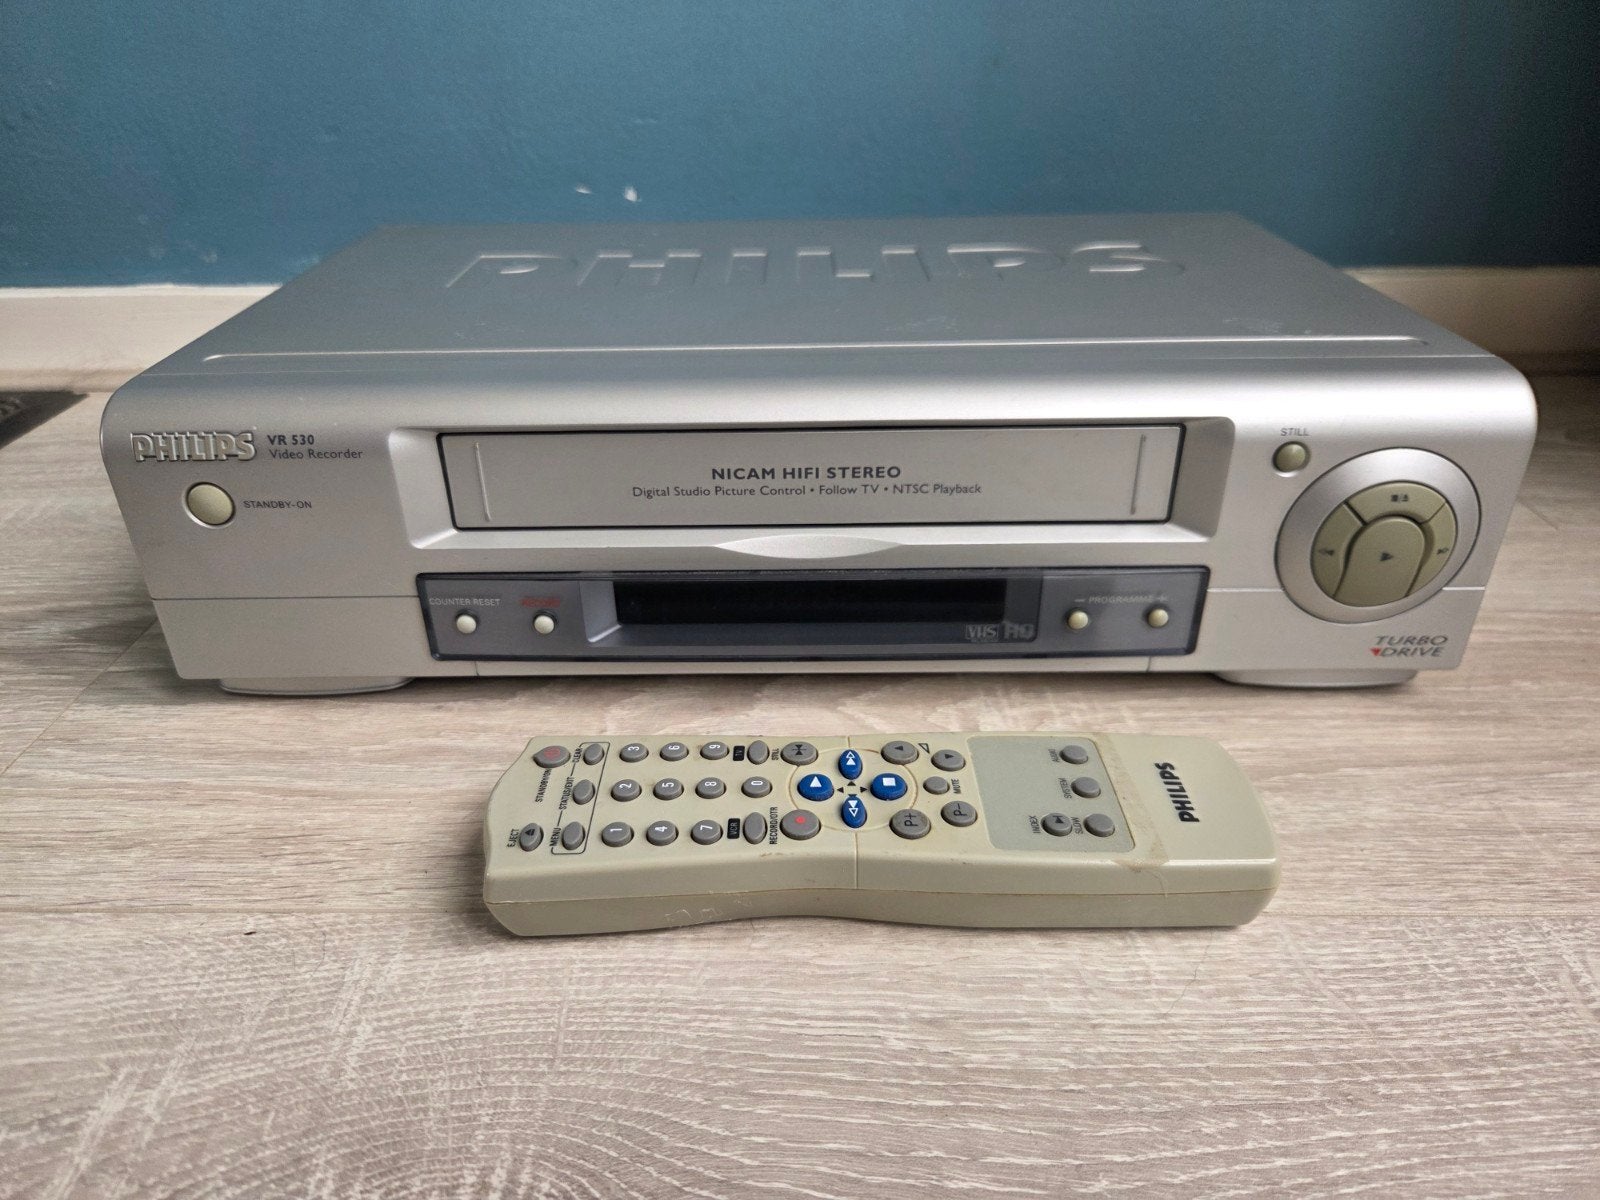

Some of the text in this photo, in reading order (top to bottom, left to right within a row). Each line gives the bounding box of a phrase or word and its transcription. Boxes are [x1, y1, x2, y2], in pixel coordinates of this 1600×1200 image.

[267, 434, 315, 446] VR 530
[1280, 427, 1310, 437] STILL
[130, 431, 257, 462] PHILIPS
[270, 448, 364, 460] Video Recorder
[711, 465, 902, 480] NICAM HIFI STEREO
[632, 482, 982, 500] Digital Studio Picture Control Follow TV NTSC Playback
[243, 499, 312, 509] STANDBY-ON
[429, 597, 501, 607] COUNTER RESET
[967, 621, 1035, 640] VHS HQ
[1375, 635, 1448, 646] TURBO
[1379, 646, 1446, 658] DRIVE
[571, 746, 584, 764] CLEAR
[771, 748, 780, 761] STILL
[558, 776, 575, 811] STATUS/EXIT
[950, 778, 962, 795] MUTE
[1058, 777, 1073, 799] SYSTEM
[1154, 761, 1200, 823] PHILIPS
[953, 802, 968, 817] P-
[769, 806, 778, 845] RECORD/OTR
[904, 811, 919, 827] P+
[1028, 814, 1041, 834] INDEX
[1070, 816, 1084, 835] SLOW
[549, 826, 562, 847] MENU
[654, 825, 668, 833] 4
[730, 820, 738, 837] VCR
[506, 827, 520, 849] EJECT
